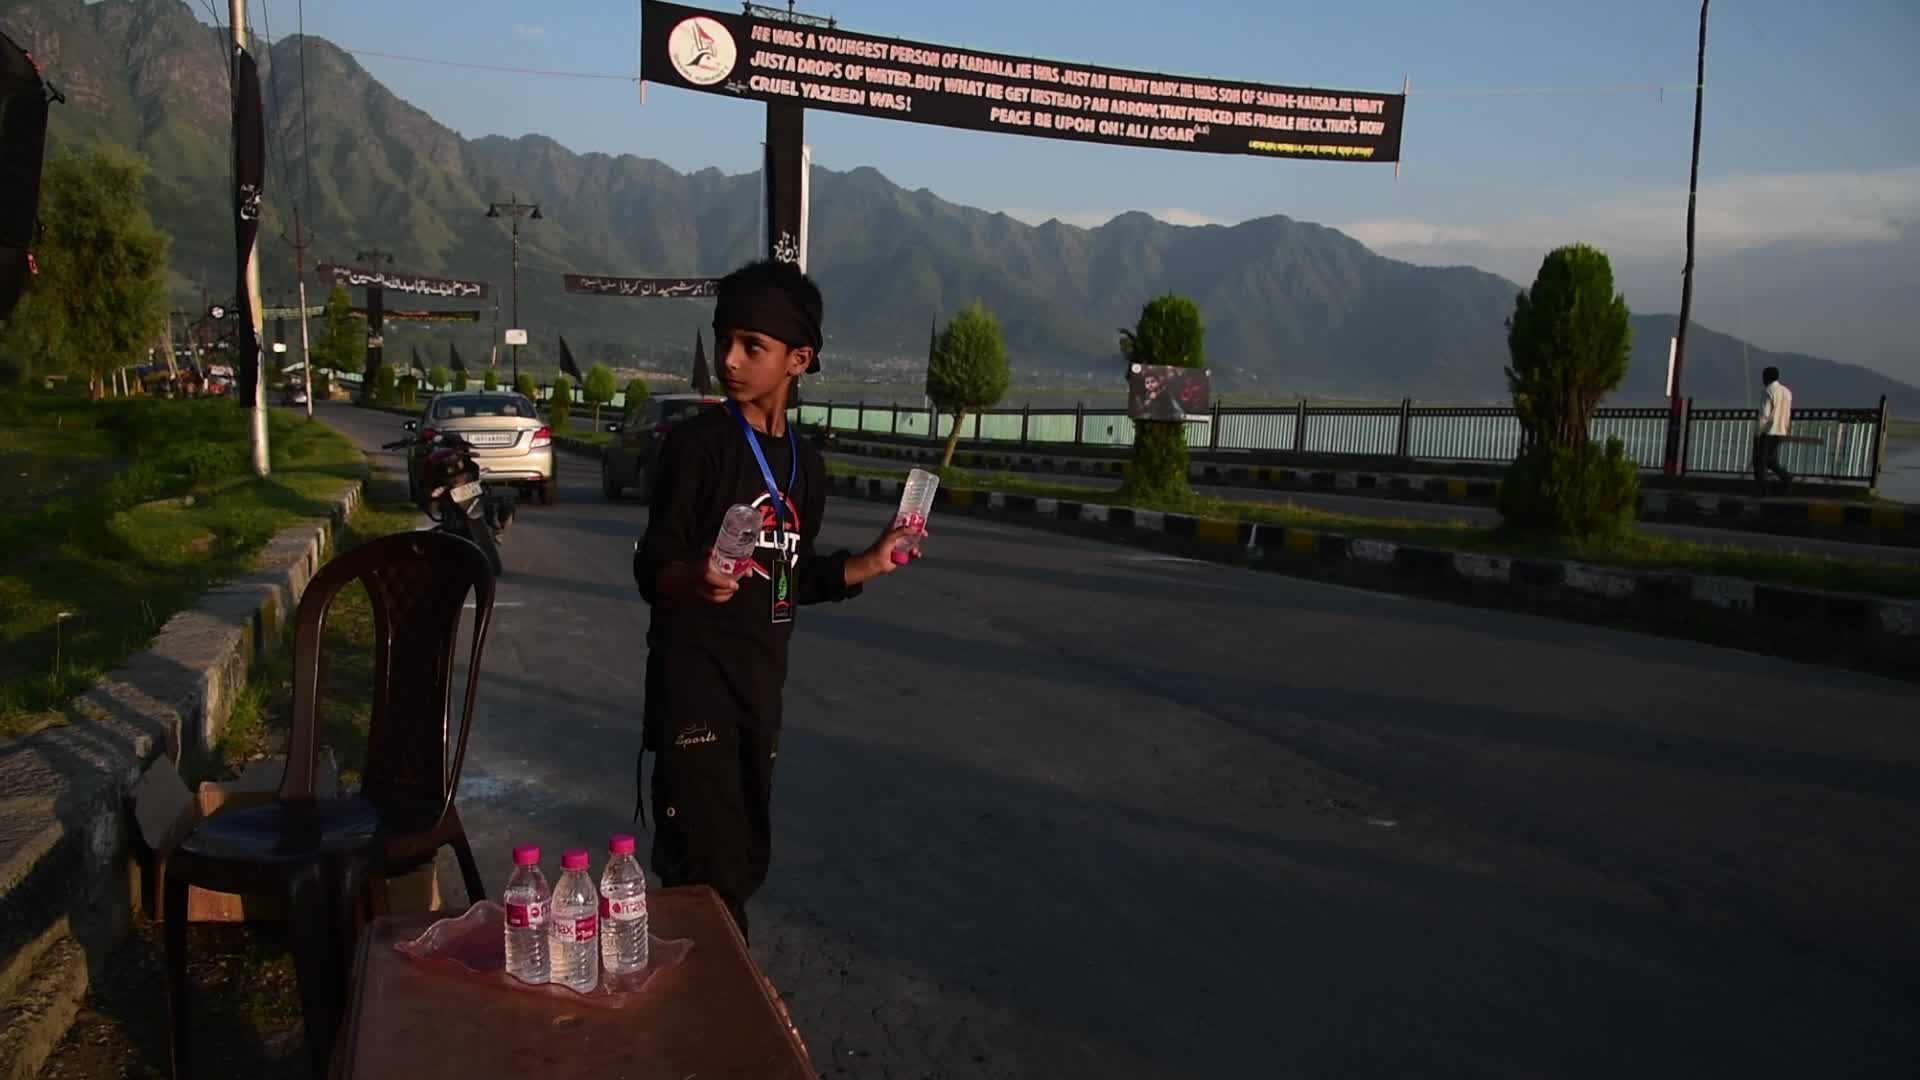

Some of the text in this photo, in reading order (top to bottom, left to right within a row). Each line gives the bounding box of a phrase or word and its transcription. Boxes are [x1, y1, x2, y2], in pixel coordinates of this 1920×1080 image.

[751, 25, 771, 42] HE
[772, 28, 804, 48] WAS
[805, 33, 816, 50] A
[818, 35, 889, 60] YOUNGEST
[889, 45, 940, 67] PERSON
[942, 53, 959, 69] OF
[1033, 64, 1059, 83] WAS
[1061, 69, 1090, 88] JUST
[1090, 73, 1107, 89] AN
[1109, 75, 1149, 94] INFANT
[1194, 84, 1218, 102] WAS
[1219, 87, 1241, 104] SON
[1242, 89, 1256, 105] OF
[750, 75, 799, 97] CRUEL
[800, 82, 866, 105] YAZEEDI
[750, 51, 786, 71] JUST
[797, 58, 843, 79] DROPS
[845, 64, 864, 81] OF
[944, 77, 985, 97] WHAT
[986, 83, 1004, 100] HE
[1005, 86, 1030, 103] GET
[1187, 107, 1233, 127] PIERCED
[1234, 111, 1252, 127] HIS
[1253, 112, 1294, 131] FRAGILE
[990, 107, 1031, 126] PEACE
[1034, 112, 1052, 128] BE
[1055, 114, 1095, 134] UPON
[1126, 124, 1149, 139] ALI
[1150, 126, 1195, 143] ASGAR
[755, 530, 801, 553] LUT
